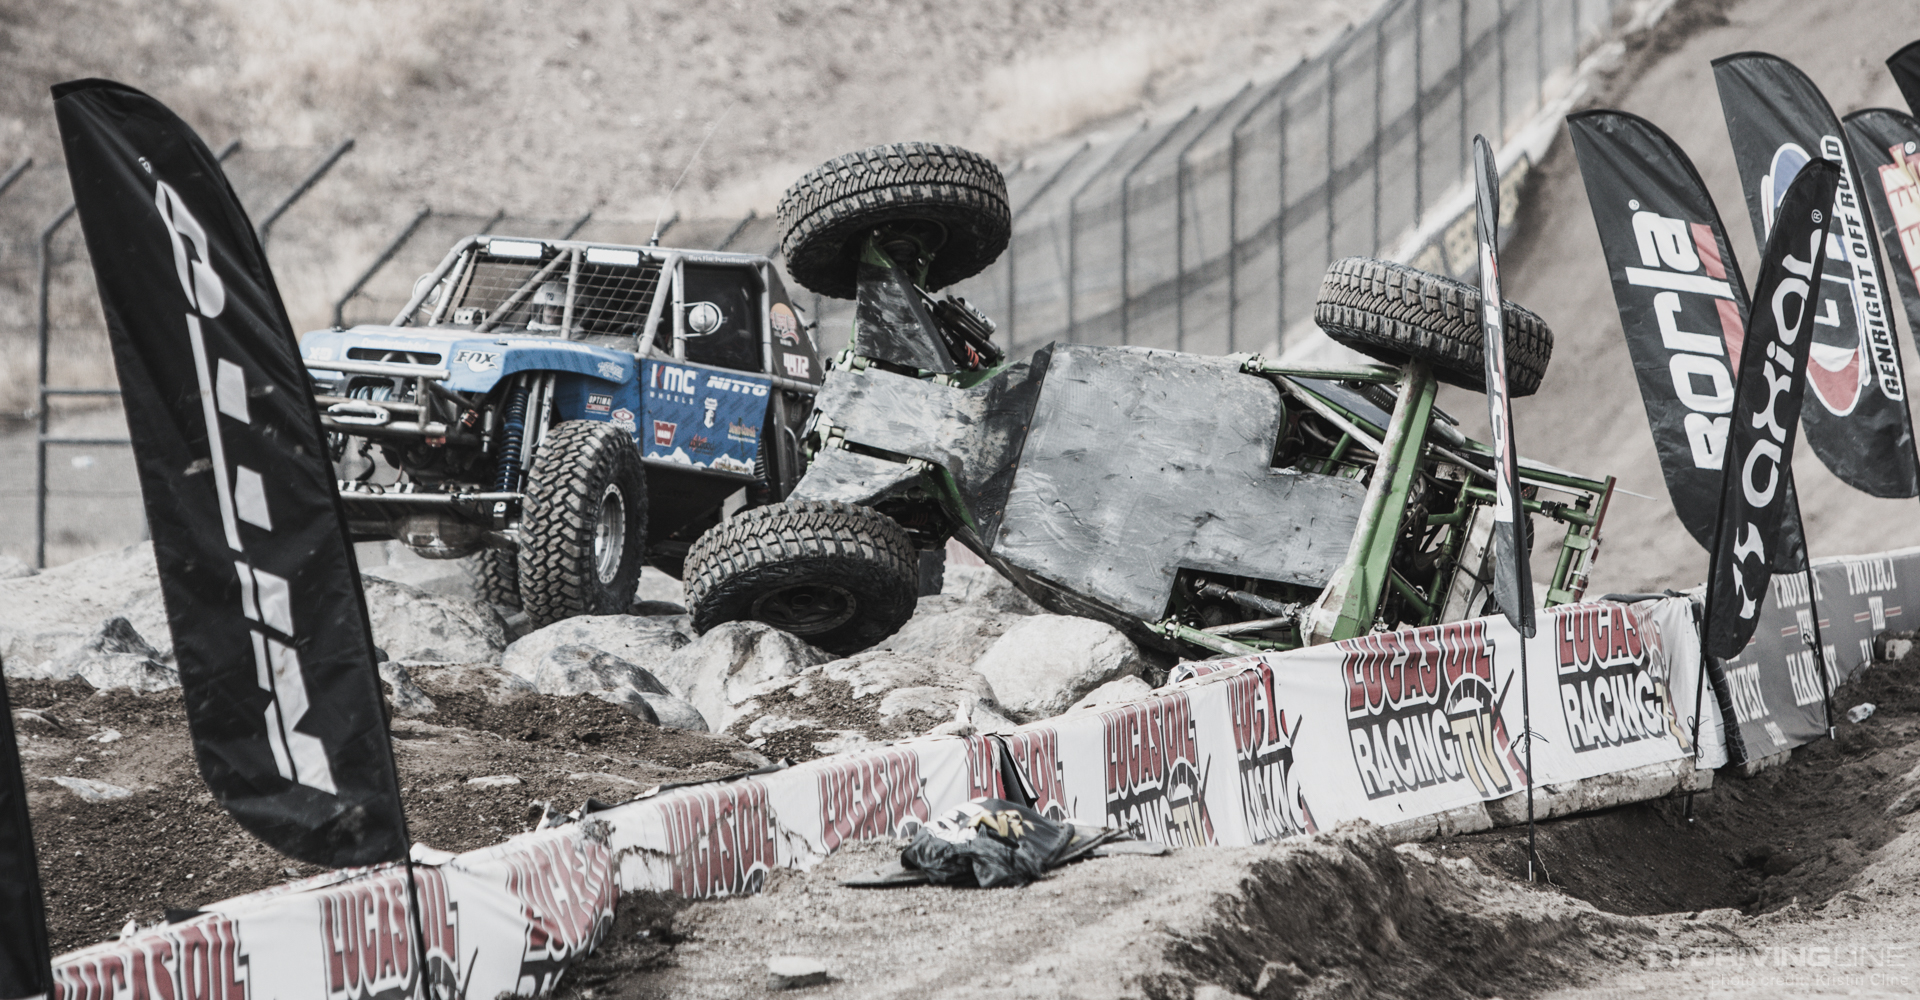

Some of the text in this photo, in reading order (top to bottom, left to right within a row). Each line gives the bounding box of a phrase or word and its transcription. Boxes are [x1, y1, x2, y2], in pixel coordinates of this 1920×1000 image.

[1825, 139, 1856, 209] ROD
[1845, 213, 1868, 259] OFF
[453, 350, 499, 364] FOX
[1857, 265, 1900, 396] GENRIGHT
[588, 395, 612, 406] OPTIMA
[649, 391, 694, 406] WHEELS
[650, 363, 697, 395] KMC
[706, 375, 769, 397] NITTO
[1770, 569, 1823, 609] PROTET
[1342, 620, 1496, 718] LUCAS OIL
[1555, 605, 1646, 674] LUCAS
[1100, 691, 1199, 798] LUCAS OIL
[1561, 670, 1665, 752] RACING
[1350, 709, 1514, 799] RACING TV
[733, 780, 778, 876] OIL
[816, 754, 889, 853] LUCAS
[884, 749, 931, 825] OIL
[320, 882, 411, 996] LUCAS
